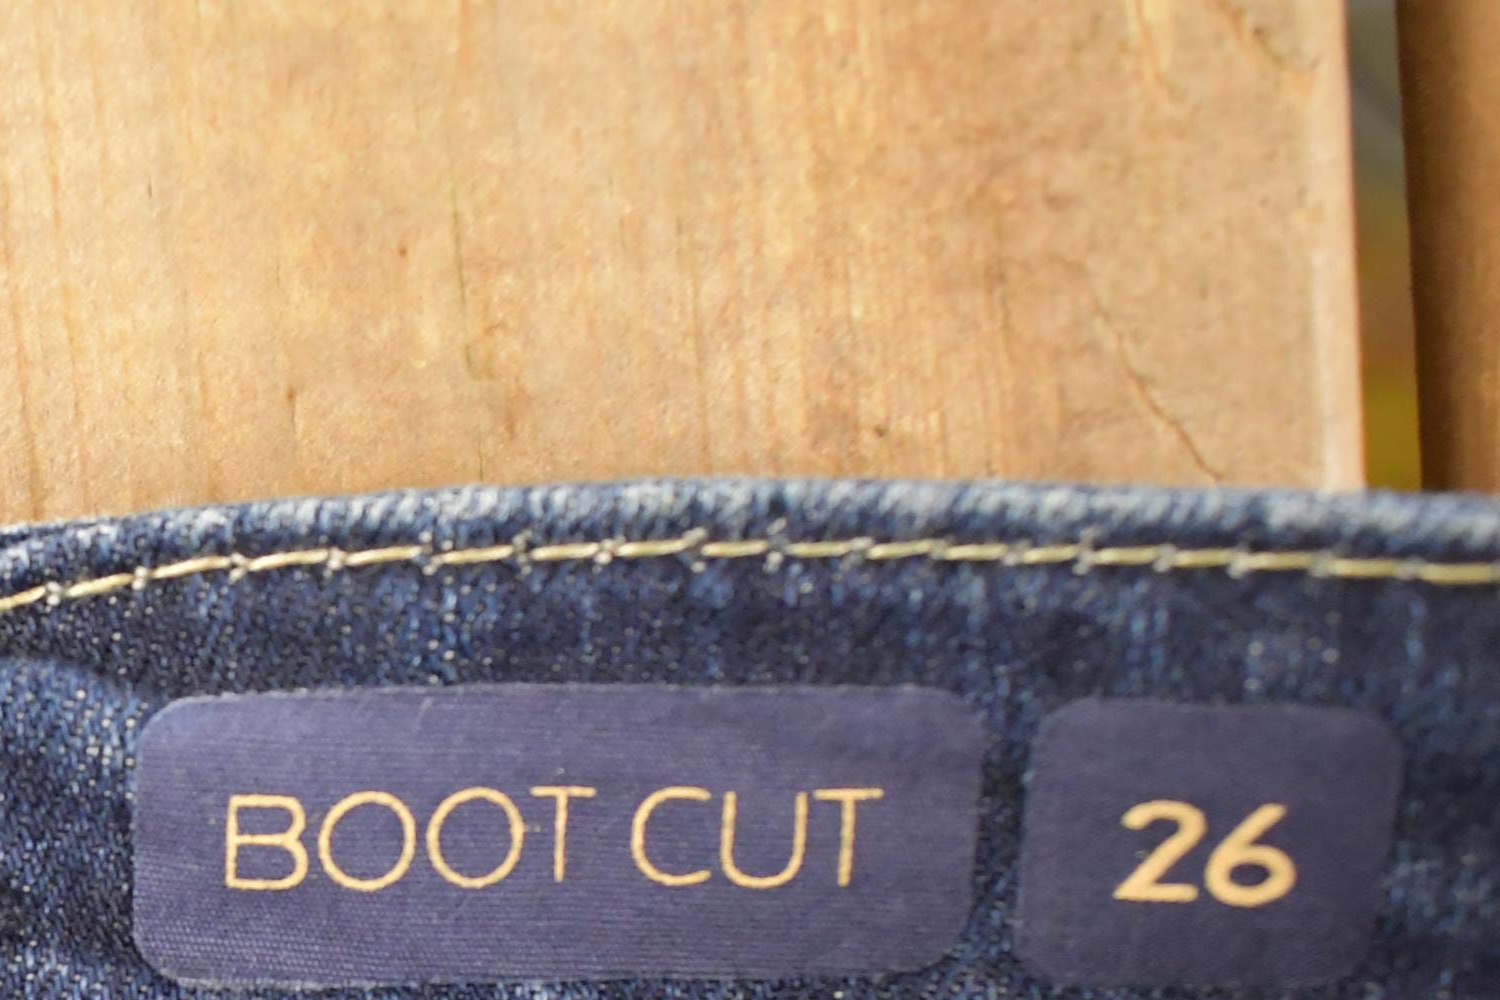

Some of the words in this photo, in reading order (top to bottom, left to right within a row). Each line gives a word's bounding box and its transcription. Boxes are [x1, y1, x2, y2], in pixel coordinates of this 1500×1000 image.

[224, 785, 596, 893] BOOT
[630, 785, 885, 889] CUT
[1112, 799, 1296, 908] 26
